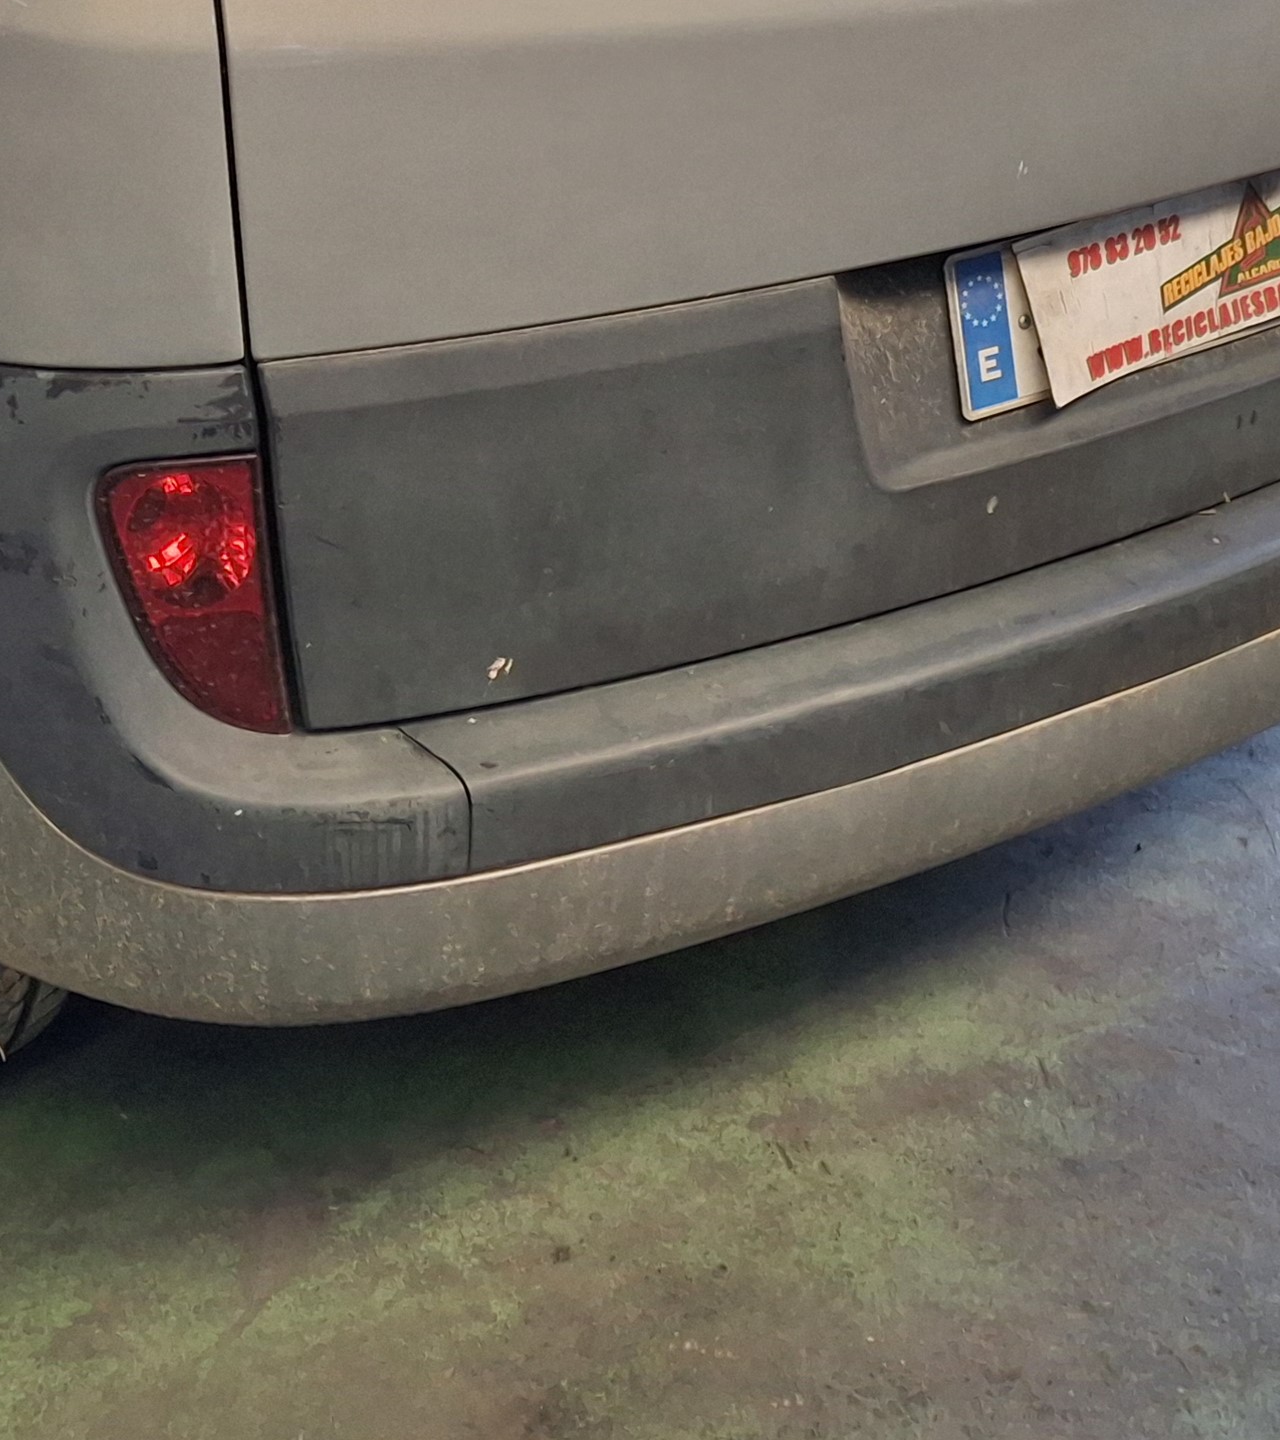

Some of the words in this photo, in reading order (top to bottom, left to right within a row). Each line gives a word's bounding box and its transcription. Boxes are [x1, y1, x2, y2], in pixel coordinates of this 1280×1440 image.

[1067, 242, 1102, 278] 978
[1131, 223, 1157, 256] 20
[1157, 214, 1182, 246] 52
[1162, 237, 1244, 308] RECICLAJES
[977, 346, 1003, 382] E
